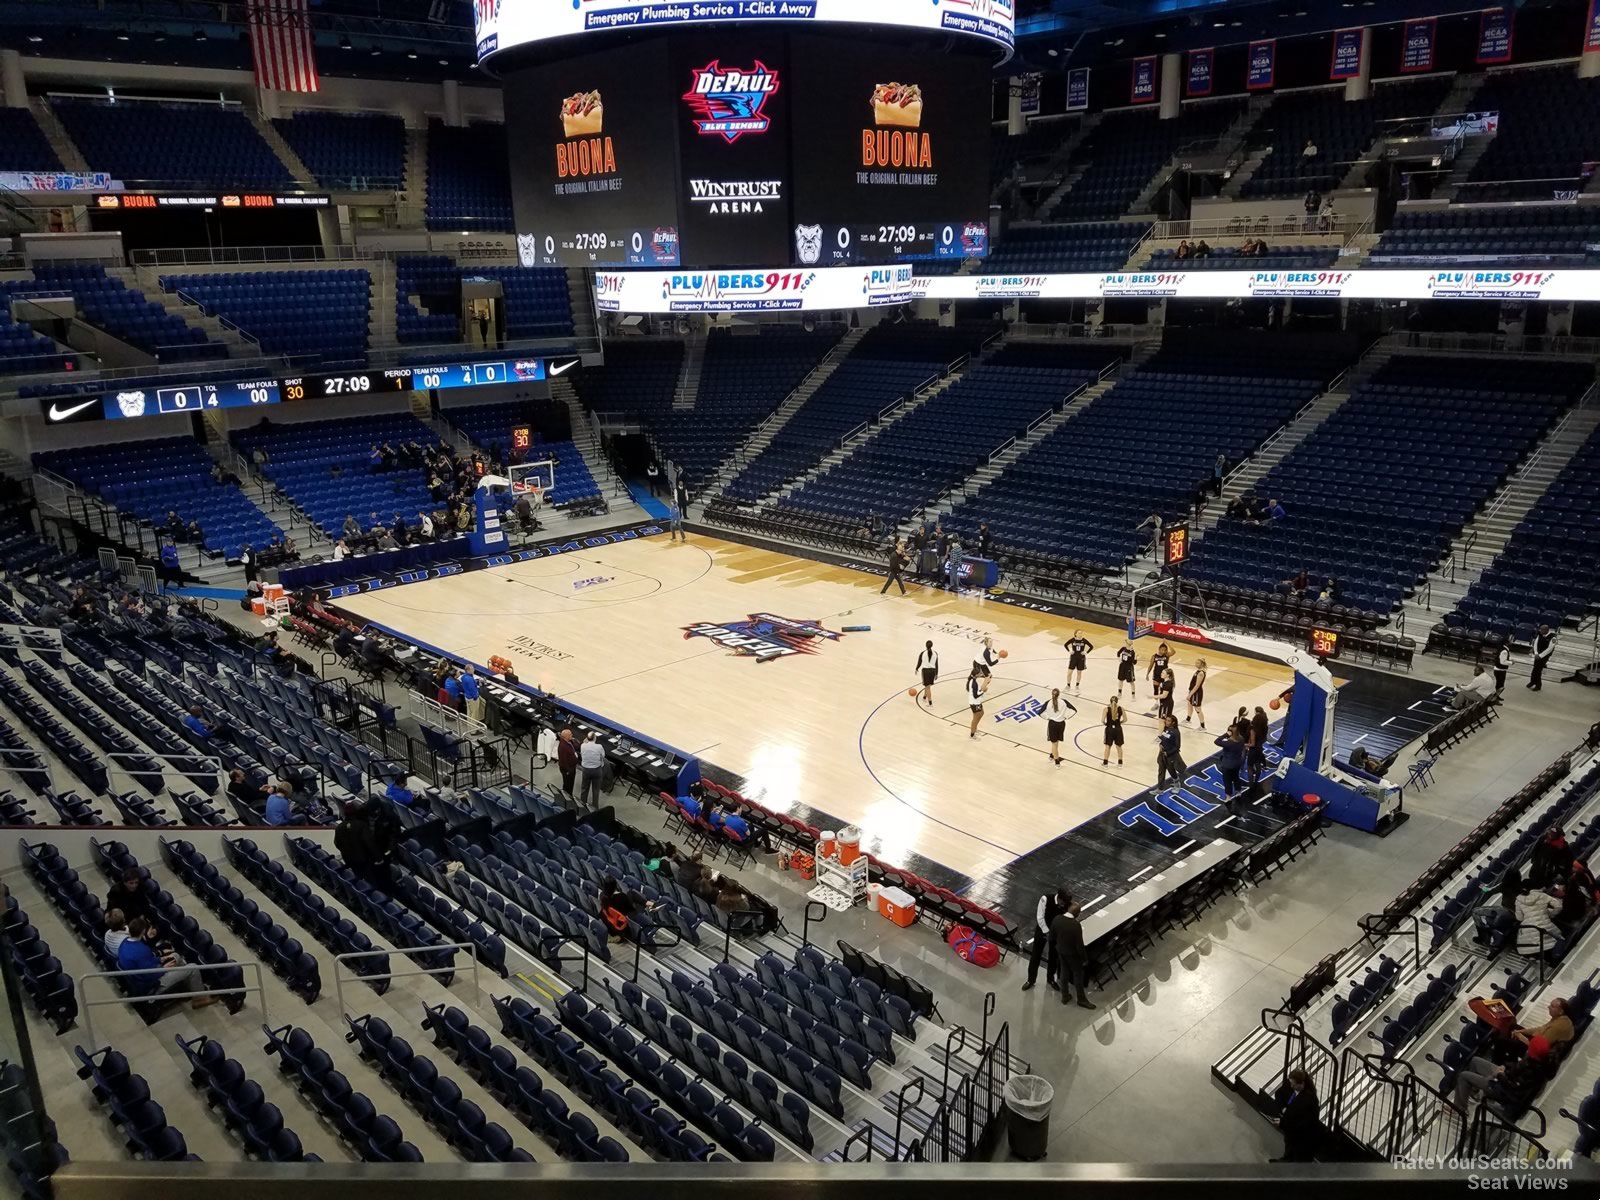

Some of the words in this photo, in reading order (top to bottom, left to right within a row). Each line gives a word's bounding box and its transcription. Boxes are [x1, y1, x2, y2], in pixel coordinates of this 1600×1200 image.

[588, 12, 639, 26] Emergency
[642, 7, 690, 22] Plumbing
[693, 4, 734, 17] Service
[738, 1, 778, 15] 1-Click
[781, 3, 812, 17] Away
[944, 12, 978, 31] Emergency
[978, 20, 998, 37] Plumbing
[1484, 28, 1508, 38] NCAA
[1408, 38, 1429, 46] NCAA
[1337, 47, 1357, 55] NCAA
[1252, 58, 1270, 66] NCAA
[1134, 84, 1152, 94] 1945
[705, 122, 726, 130] BLUE
[729, 122, 764, 130] DEMONS
[863, 129, 932, 167] BUONA
[556, 137, 616, 177] BUONA
[856, 172, 869, 184] THE
[870, 172, 898, 185] ORIGINAL
[899, 173, 922, 185] ITALIAN
[922, 174, 938, 186] BEEF
[555, 183, 565, 195] THE
[565, 181, 588, 194] ORIGINAL
[588, 180, 609, 192] ITALIAN
[609, 178, 622, 191] BEEF
[123, 196, 156, 207] BUONA
[244, 196, 274, 206] BUONA
[709, 202, 763, 213] ARENA
[576, 233, 607, 249] 27:09
[837, 227, 850, 249] 0
[878, 226, 916, 243] 27:09
[942, 226, 953, 245] 0
[545, 235, 555, 255] 0
[632, 232, 643, 253] 0
[894, 246, 902, 254] 1st
[589, 253, 597, 261] 1st
[671, 301, 703, 310] Emergency
[703, 300, 732, 310] Plumbing
[733, 300, 756, 309] Service
[759, 300, 780, 308] 1-Click
[782, 300, 800, 308] Away
[384, 369, 411, 378] PERIOD
[414, 367, 429, 375] TEAM
[429, 366, 448, 374] FOULS
[486, 367, 495, 381] 0
[396, 378, 402, 389] 1
[423, 375, 440, 388] 00
[463, 371, 472, 384] 4
[236, 382, 255, 390] TEAM
[256, 380, 278, 388] FOULS
[324, 376, 370, 393] 27:09
[250, 388, 268, 403] 00
[287, 386, 304, 399] 30
[175, 391, 187, 408] 0
[207, 393, 219, 407] 4
[517, 436, 528, 446] 30
[1170, 541, 1183, 561] 30
[327, 563, 464, 600] BLUE
[486, 525, 664, 568] DEMONS
[1314, 630, 1337, 642] 27:08
[505, 645, 543, 660] ARENA
[1318, 640, 1331, 652] 30
